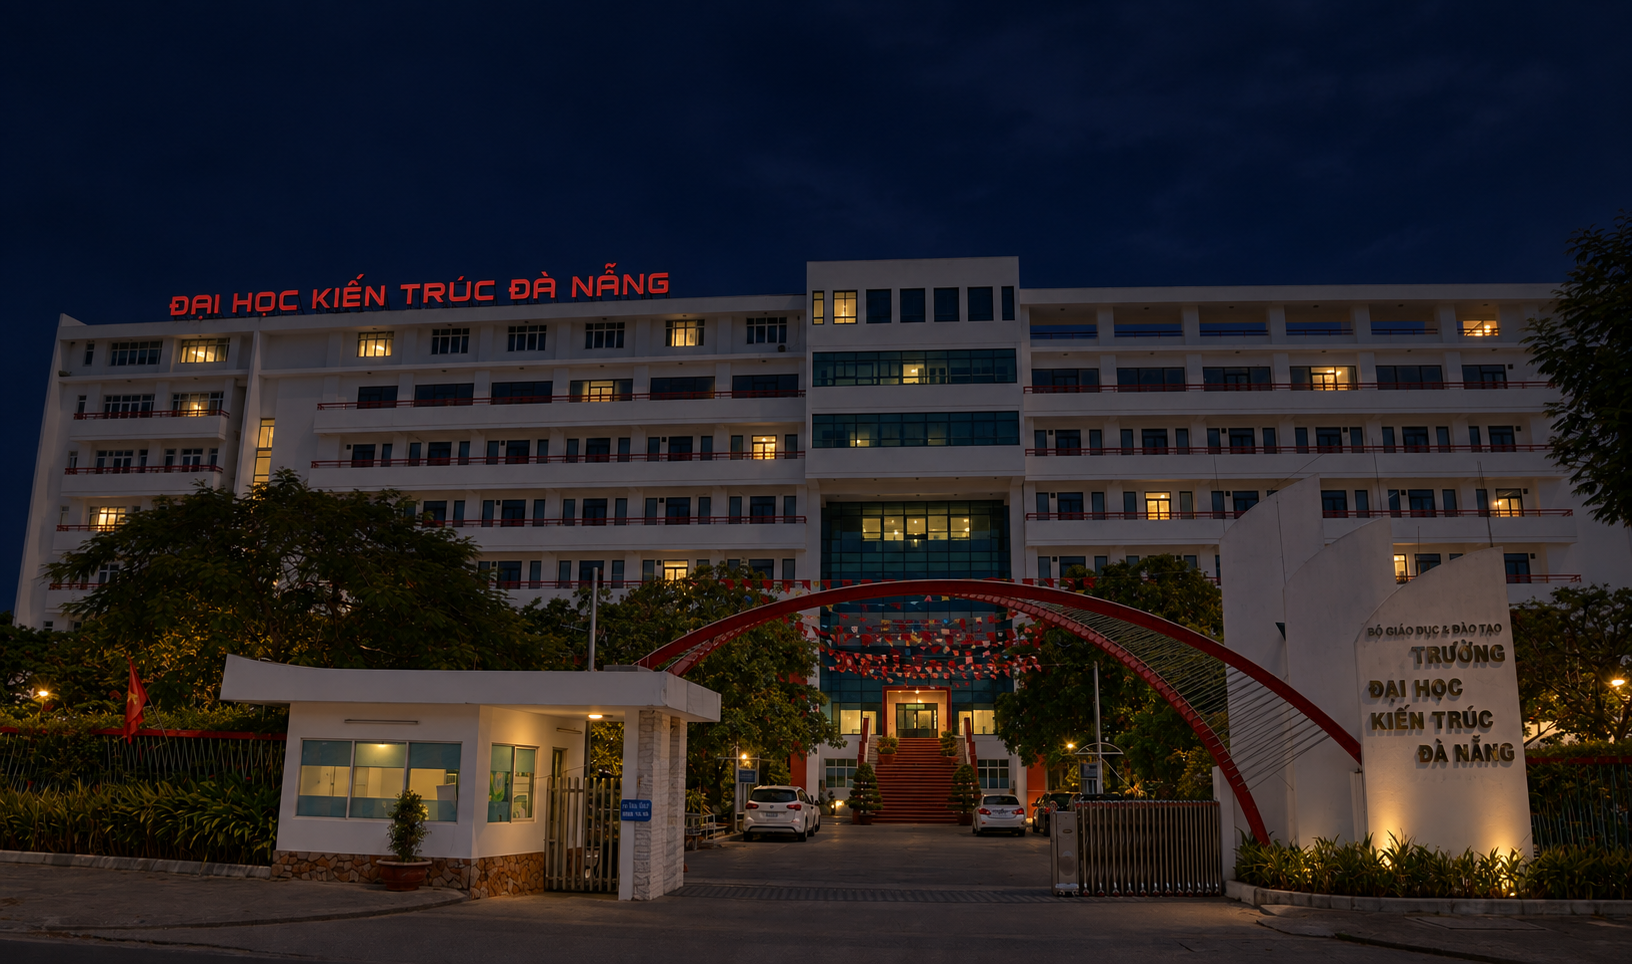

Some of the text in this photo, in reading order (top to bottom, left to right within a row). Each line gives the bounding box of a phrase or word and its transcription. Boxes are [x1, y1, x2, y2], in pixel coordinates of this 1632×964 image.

[169, 294, 220, 320] ĐẠI
[232, 290, 299, 317] HỌC
[311, 273, 386, 309] KIẾN
[400, 275, 495, 305] TRÚC
[508, 271, 556, 300] ĐÀ
[1386, 623, 1414, 636] GIÁO
[1442, 625, 1450, 634] &
[1452, 621, 1477, 634] ĐÀO
[1479, 623, 1503, 636] TẠO
[1411, 639, 1506, 664] TRƯỜNG
[1368, 678, 1463, 703] ĐẠI HỌC
[1370, 704, 1494, 730] KIẾN TRÚC
[1418, 738, 1449, 763] ĐÀ
